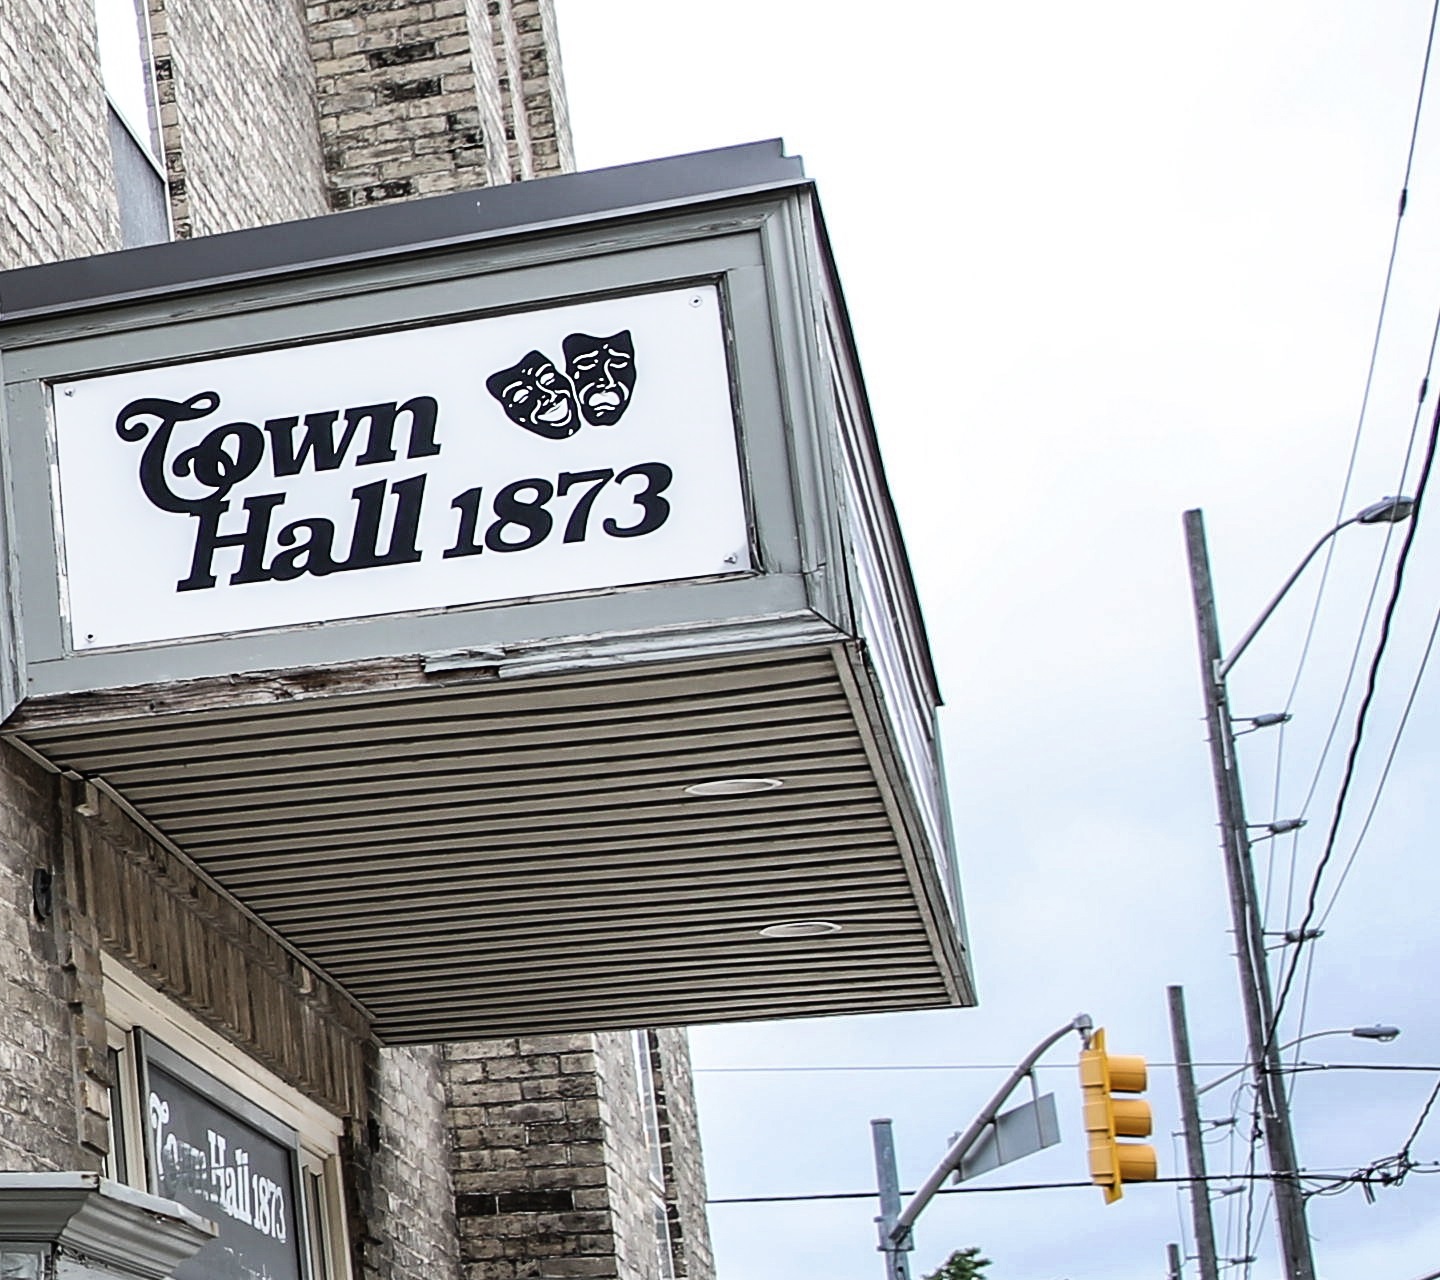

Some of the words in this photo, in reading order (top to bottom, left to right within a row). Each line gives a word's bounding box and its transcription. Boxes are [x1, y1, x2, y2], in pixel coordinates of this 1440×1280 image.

[115, 390, 441, 515] Town
[176, 472, 428, 593] Hall
[442, 461, 673, 561] 1873
[207, 1129, 252, 1225] Hall
[251, 1173, 287, 1243] 1873
